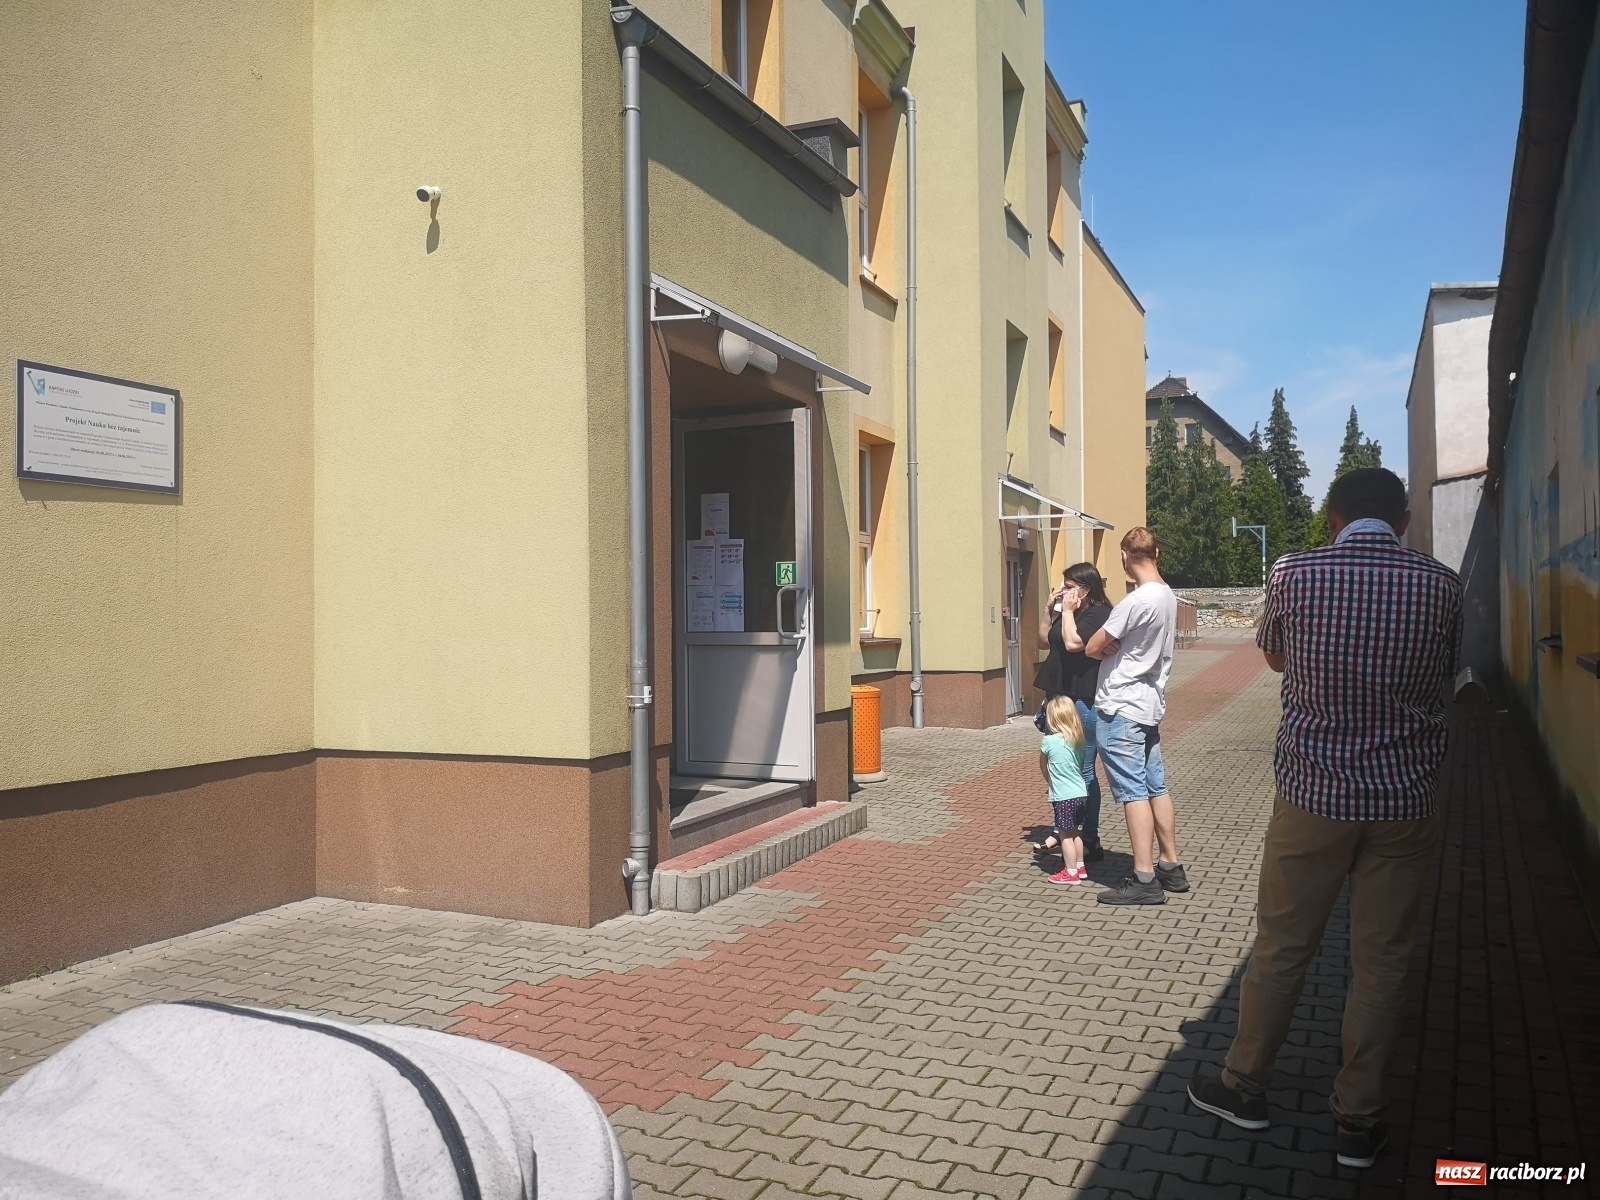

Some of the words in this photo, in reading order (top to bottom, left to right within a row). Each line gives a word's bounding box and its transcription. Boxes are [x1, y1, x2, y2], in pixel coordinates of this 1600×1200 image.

[65, 416, 87, 425] Projekt
[87, 419, 106, 428] Nauka
[107, 423, 117, 431] bez
[117, 425, 141, 434] tajemnic
